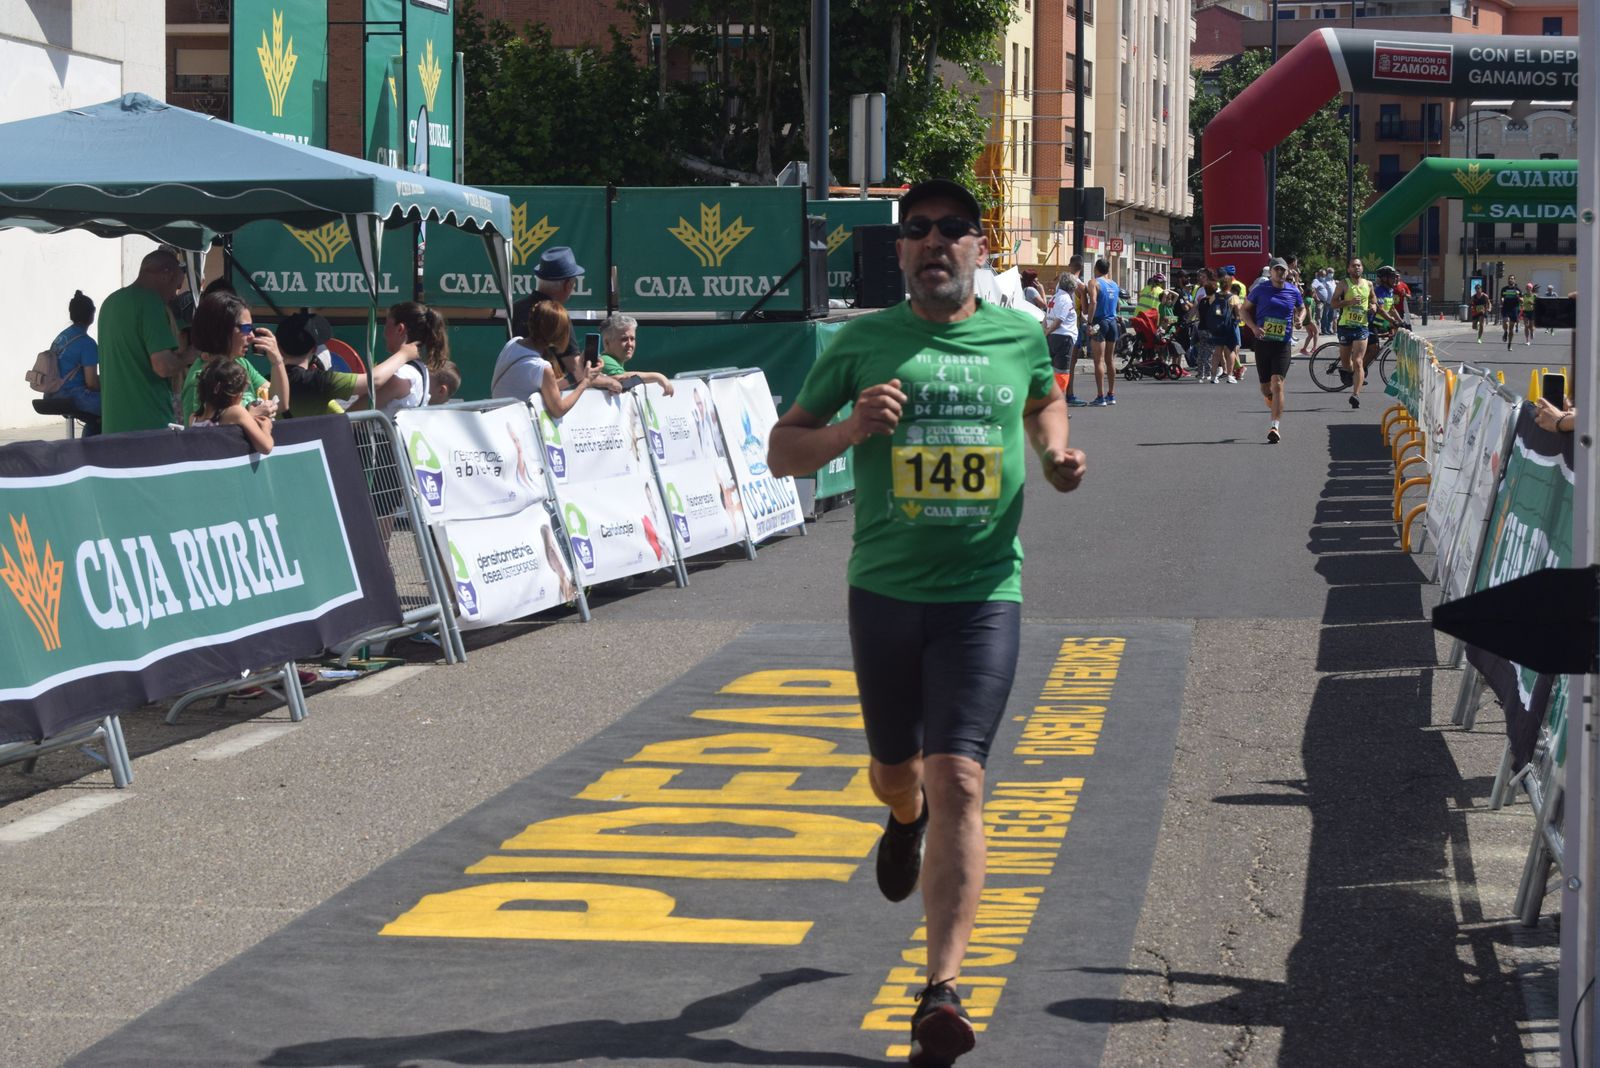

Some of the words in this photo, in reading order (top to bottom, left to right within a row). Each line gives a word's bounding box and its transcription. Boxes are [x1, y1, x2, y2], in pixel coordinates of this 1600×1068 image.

[1392, 54, 1436, 65] DIPUTACIÓN
[1437, 57, 1447, 65] DE
[1469, 47, 1509, 62] CON
[1514, 49, 1536, 63] EL
[1540, 50, 1579, 65] DEP
[1391, 62, 1448, 77] ZAMORA
[1468, 68, 1558, 87] GANAMOS
[1496, 169, 1547, 188] CAJA
[1548, 170, 1579, 188] RU
[1489, 203, 1578, 218] SALIDA
[1220, 240, 1260, 248] ZAMORA
[250, 271, 306, 293] CAJA
[440, 273, 500, 295] CAJA
[634, 276, 695, 298] CAJA
[702, 275, 789, 297] RURAL
[1266, 323, 1283, 334] 213
[915, 353, 932, 363] VII
[938, 404, 992, 416] ZAMORA
[905, 452, 985, 493] 148
[924, 506, 953, 517] CAJA
[956, 506, 992, 517] RURAL
[76, 535, 183, 630] CAJA
[170, 513, 305, 611] RURAL
[1011, 704, 1107, 755] DISEÑO
[983, 777, 1086, 876] INTEGRAL
